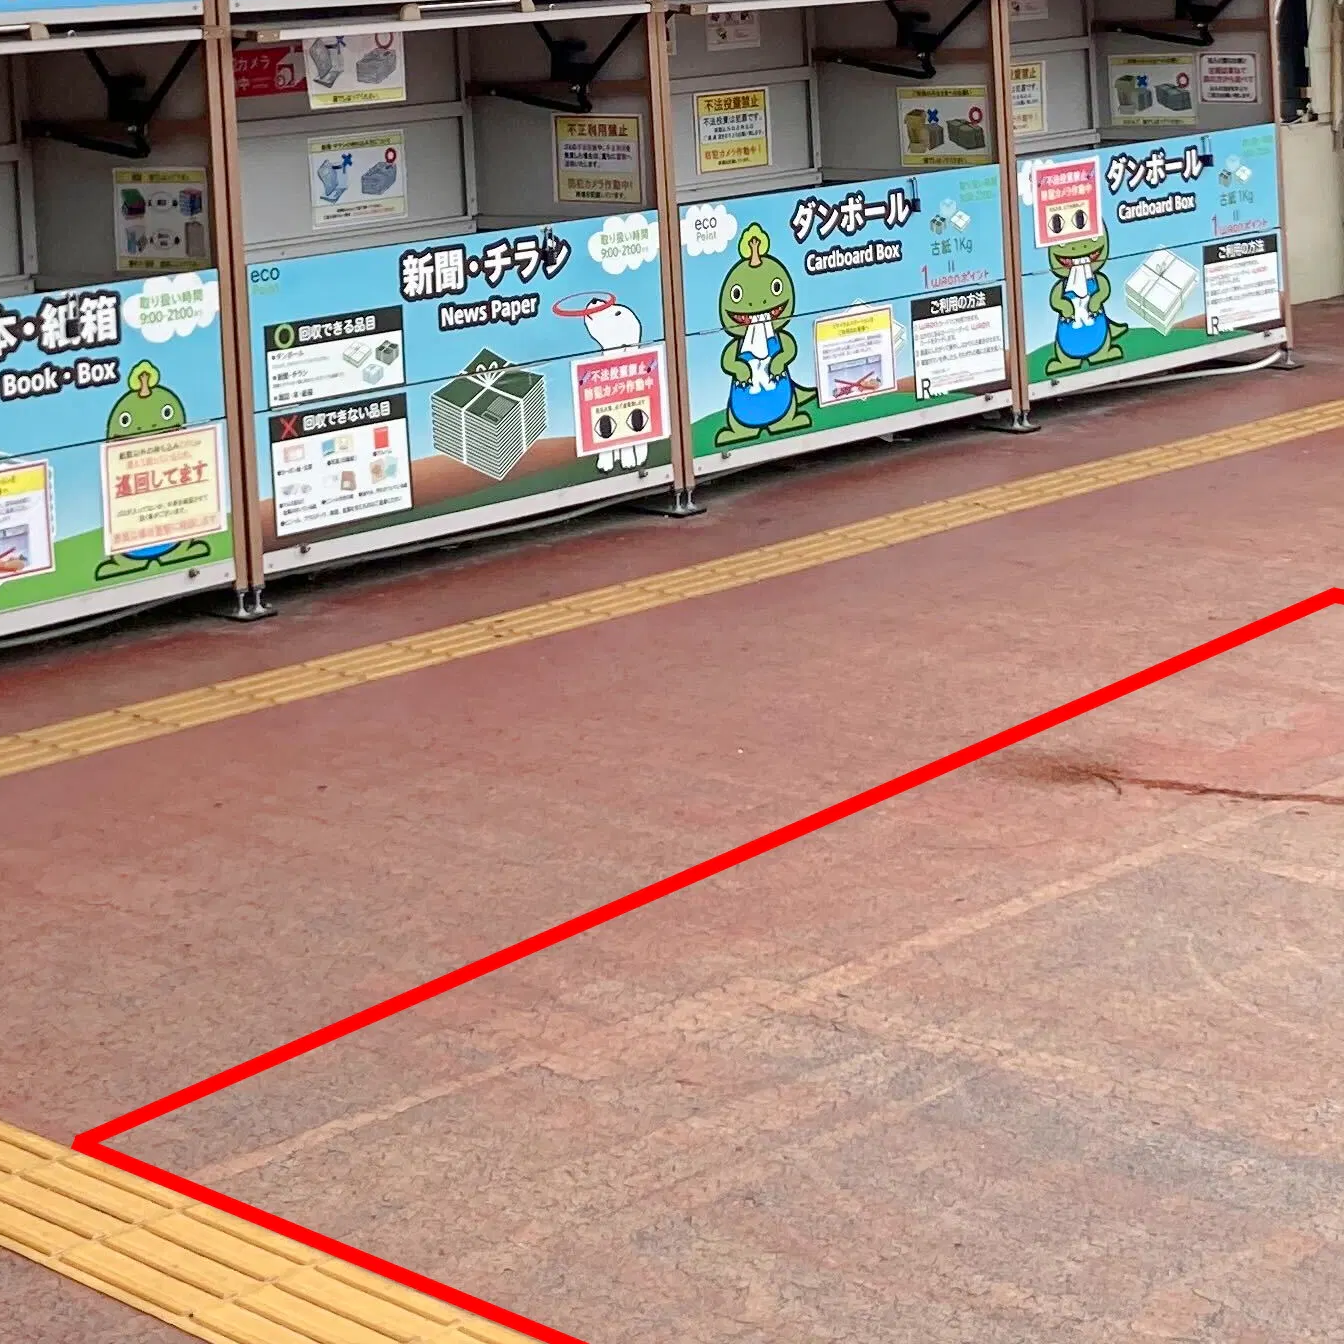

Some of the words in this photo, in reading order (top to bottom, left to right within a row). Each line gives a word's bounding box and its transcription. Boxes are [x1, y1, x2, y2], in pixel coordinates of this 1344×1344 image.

[1106, 148, 1203, 190] ダンボール
[793, 193, 909, 238] ダンボール
[1118, 197, 1174, 220] Cardboard
[1175, 194, 1196, 211] Box
[694, 217, 718, 230] eco
[806, 247, 875, 273] Cardboard
[877, 243, 901, 261] Box
[250, 268, 281, 283] eco
[140, 288, 204, 309] 取り扱い時間
[441, 304, 488, 328] News
[490, 296, 538, 324] Paper
[930, 291, 987, 315] ご利用の方法
[298, 315, 377, 342] 回収できる品目
[302, 401, 392, 432] 回収できない品目
